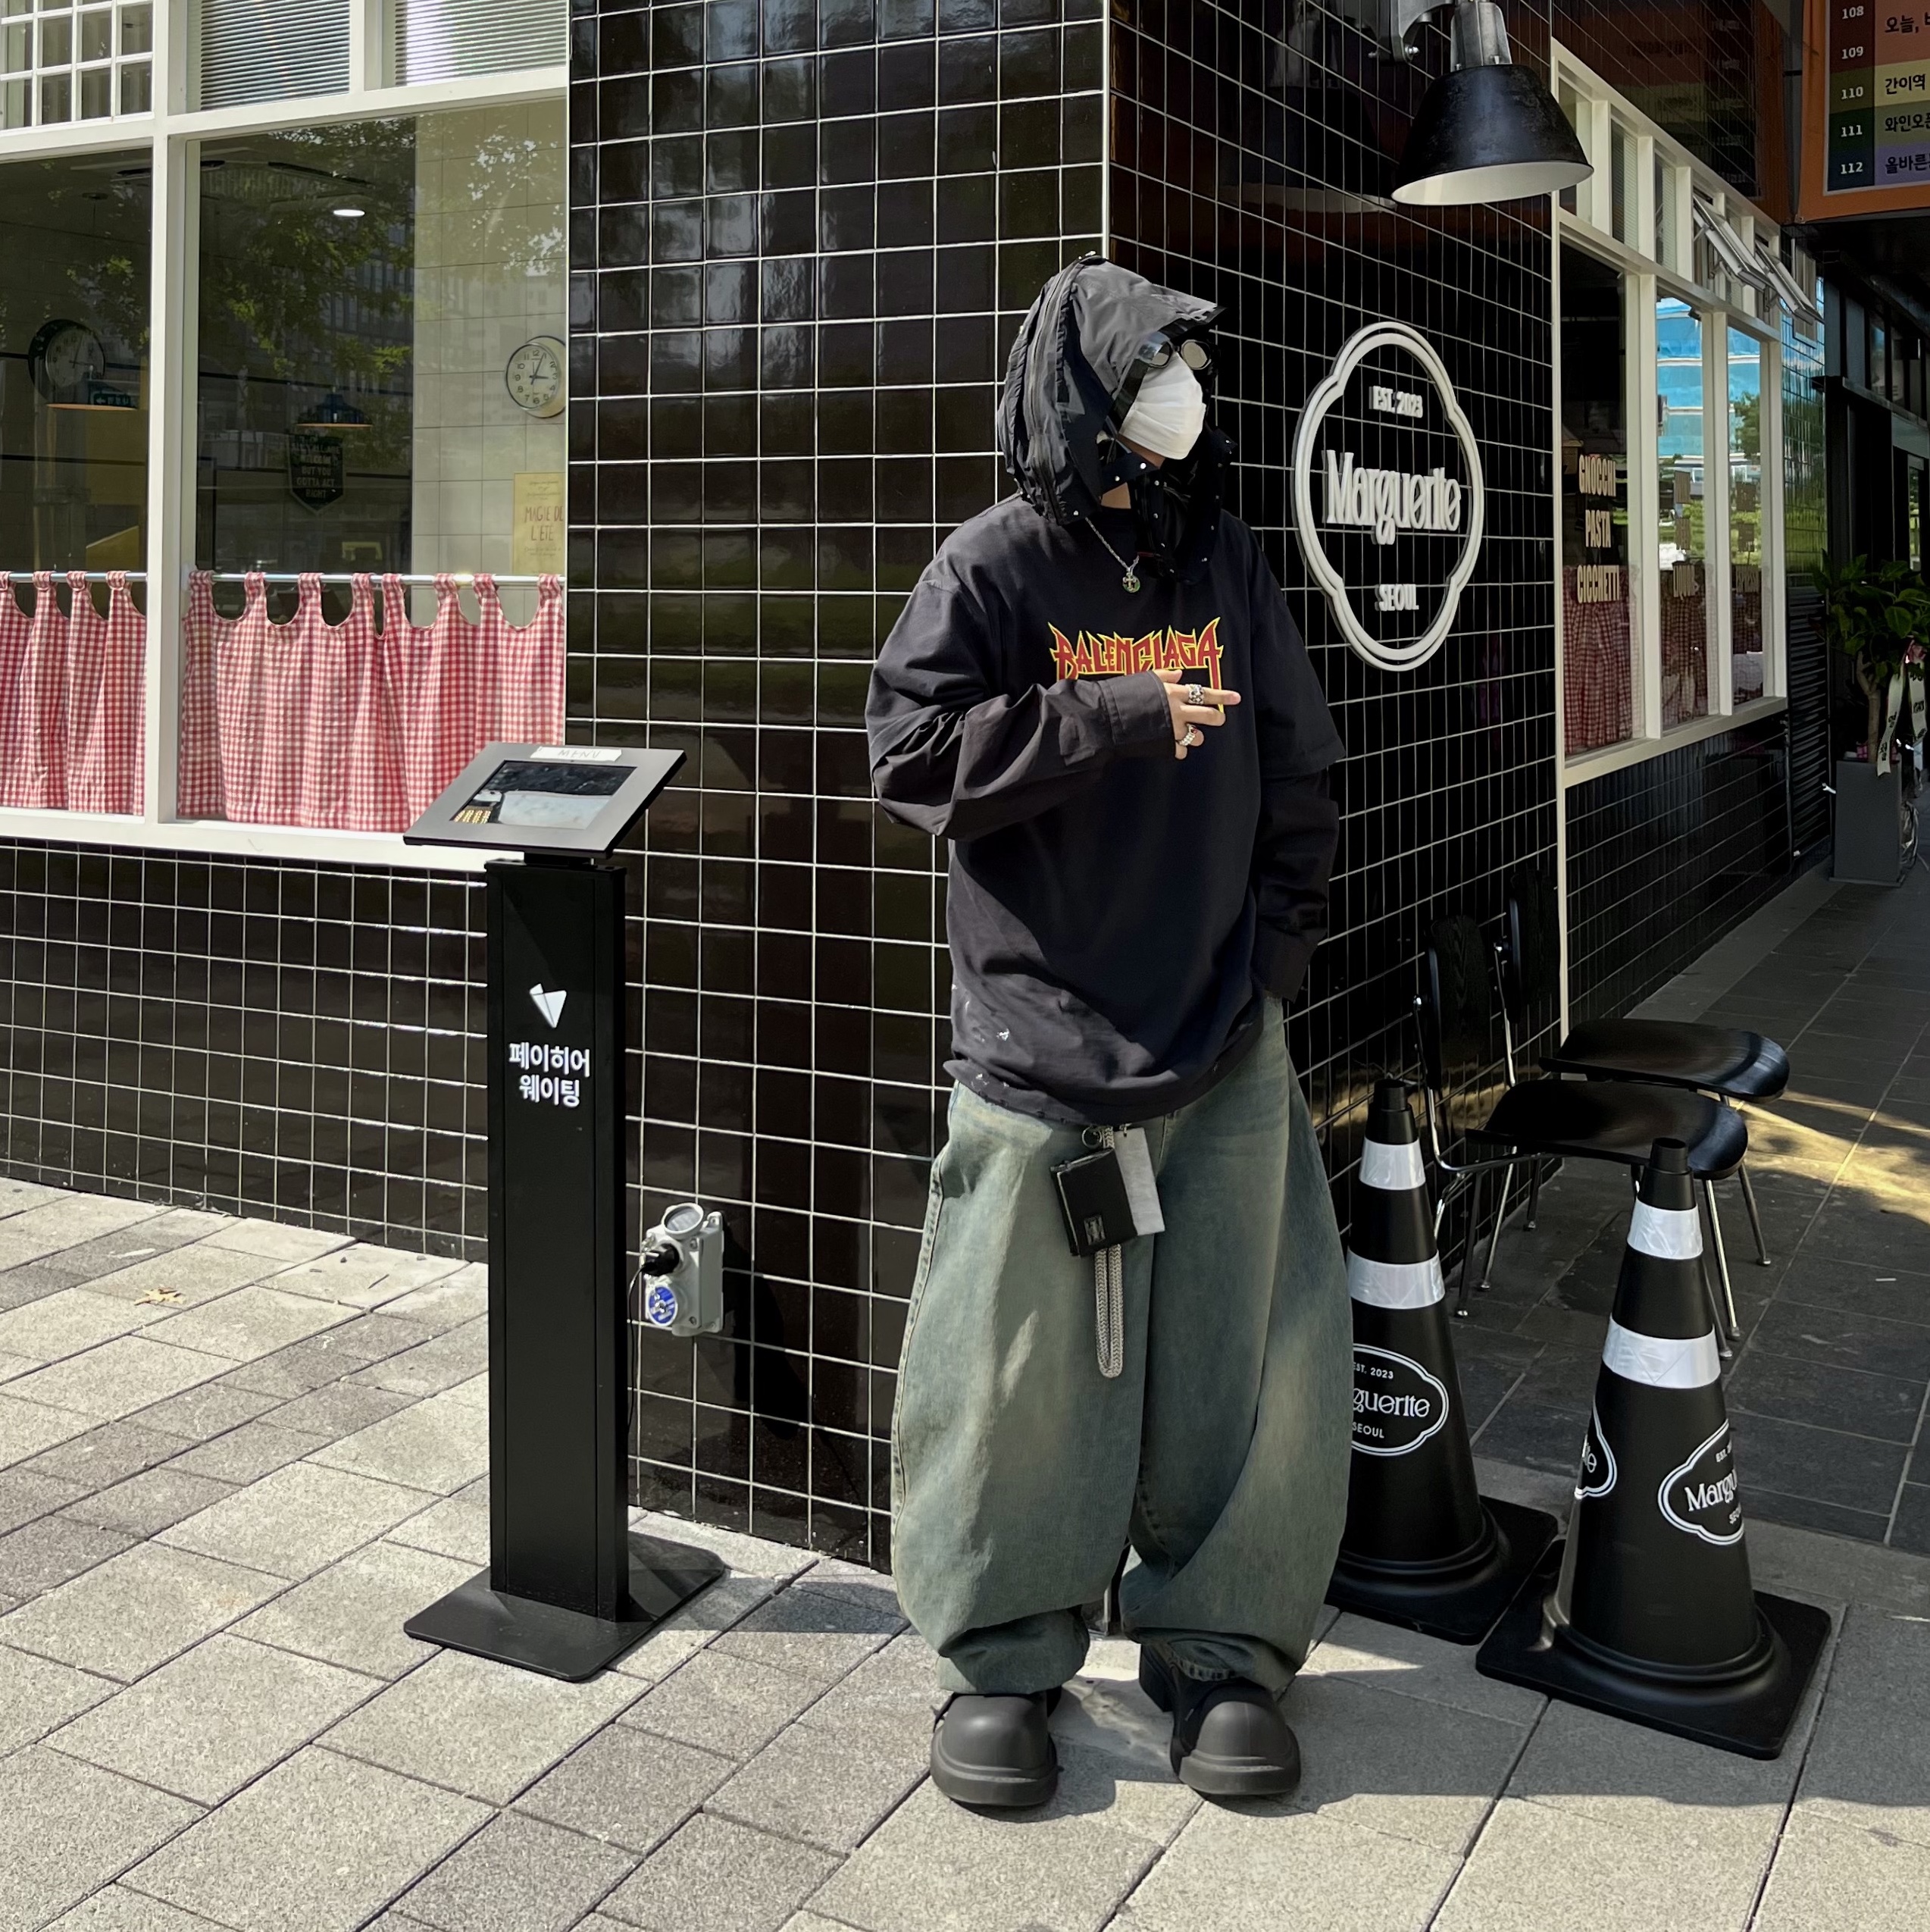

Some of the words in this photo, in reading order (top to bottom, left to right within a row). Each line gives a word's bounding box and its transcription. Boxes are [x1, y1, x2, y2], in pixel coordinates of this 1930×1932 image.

[1842, 6, 1864, 20] 108
[1841, 46, 1864, 59] 109
[1841, 86, 1863, 99] 110
[1885, 74, 1926, 95] 간이역
[1841, 124, 1863, 137] 111
[1840, 161, 1863, 174] 112
[1372, 385, 1395, 414] EST.
[1397, 391, 1423, 418] 2023
[1579, 454, 1616, 497] GNOCCHI
[1323, 449, 1461, 545] Marguerite
[1585, 509, 1612, 548] PASTA
[1379, 584, 1419, 611] SEOUL
[1577, 564, 1620, 604] CICCHETTI
[1048, 617, 1224, 694] BALENCIAGA
[558, 749, 601, 759] MENU
[508, 1041, 590, 1078] 페이히어
[519, 1074, 580, 1107] 웨이팅
[1370, 1367, 1394, 1379] 2023
[1353, 1388, 1431, 1417] guerite
[1352, 1421, 1385, 1439] SEOUL
[1684, 1467, 1738, 1511] Margu
